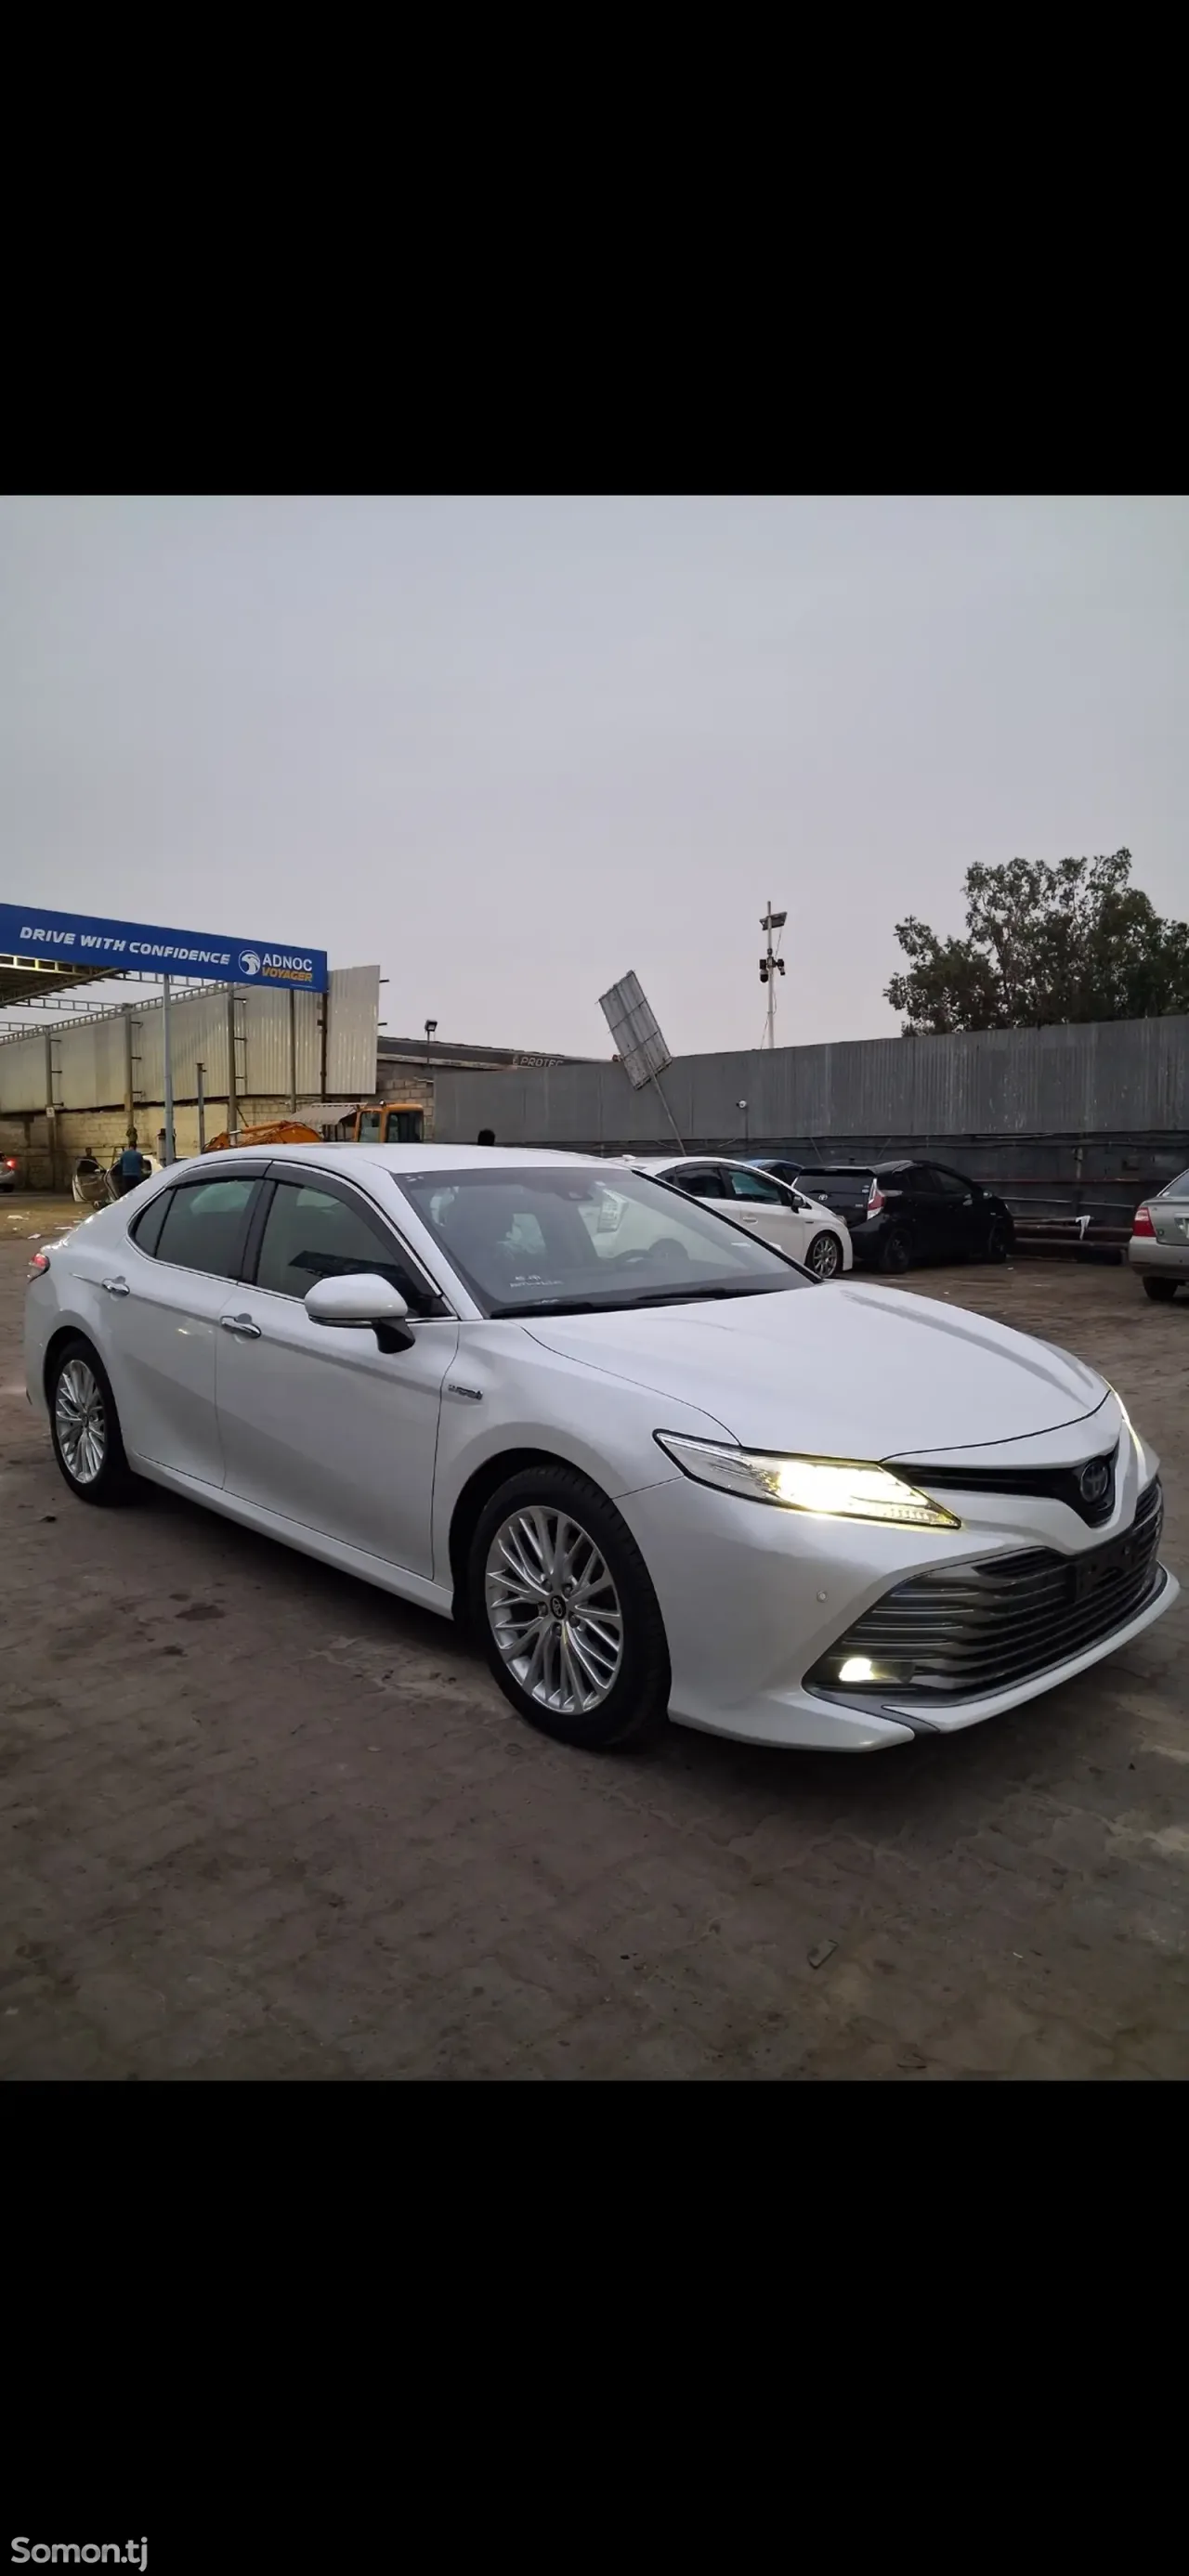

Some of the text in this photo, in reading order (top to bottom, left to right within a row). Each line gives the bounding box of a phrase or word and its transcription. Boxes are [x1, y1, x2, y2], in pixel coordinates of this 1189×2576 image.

[20, 926, 231, 966] DRIVE WITH CONFIDENCE
[262, 953, 313, 971] ADNOC
[262, 966, 313, 982] VOYAGER
